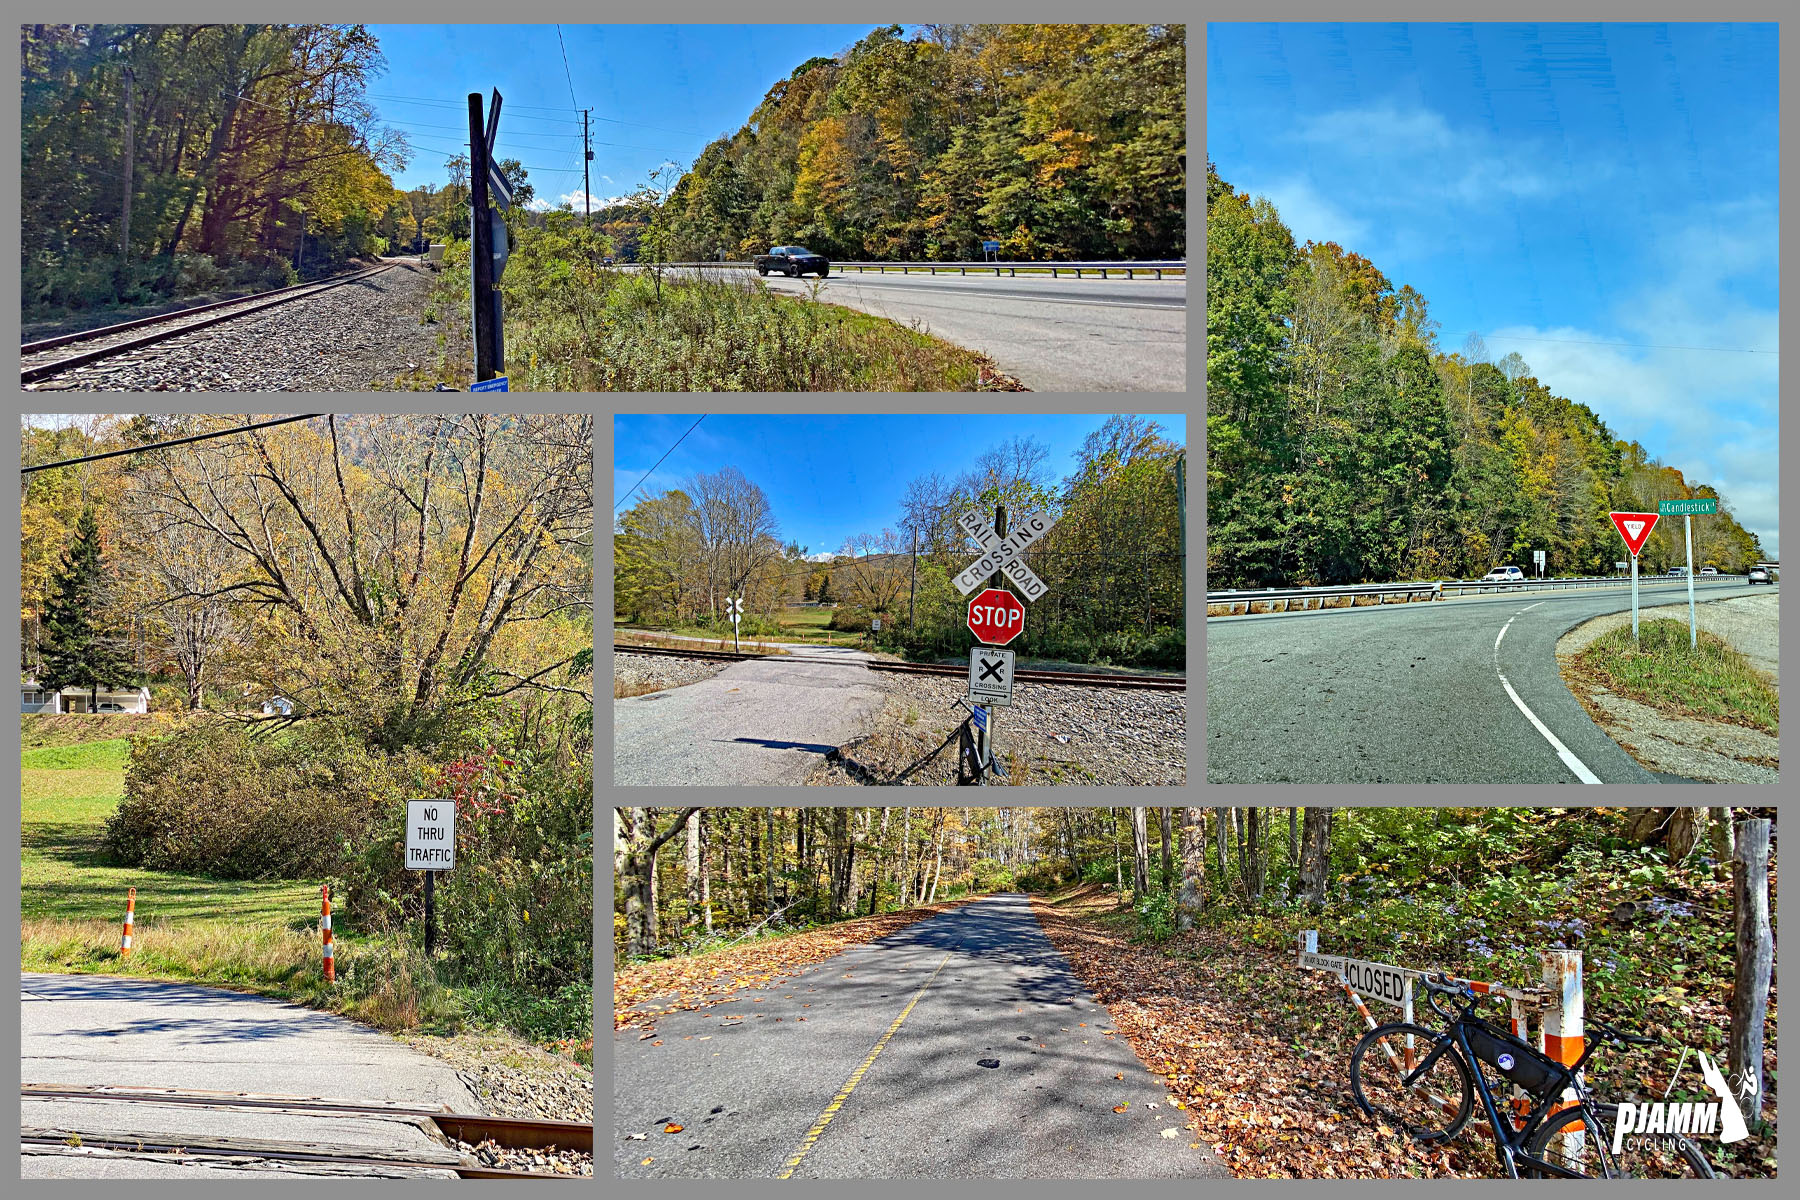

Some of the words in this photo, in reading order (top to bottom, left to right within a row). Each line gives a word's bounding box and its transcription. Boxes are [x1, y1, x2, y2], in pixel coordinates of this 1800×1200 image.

[1666, 502, 1710, 513] Candlestick
[961, 519, 1044, 587] CROSSING
[962, 513, 992, 548] RAIL
[1004, 559, 1041, 596] ROAD
[971, 605, 1020, 629] STOP
[979, 650, 1006, 659] PRIVATE
[974, 682, 1007, 691] CROSSING
[423, 808, 438, 821] NO
[417, 827, 444, 840] THRU
[409, 848, 451, 862] TRAFFIC
[1316, 957, 1330, 967] BLOCK
[1330, 960, 1343, 970] GATE
[1349, 963, 1404, 1002] CLOSED
